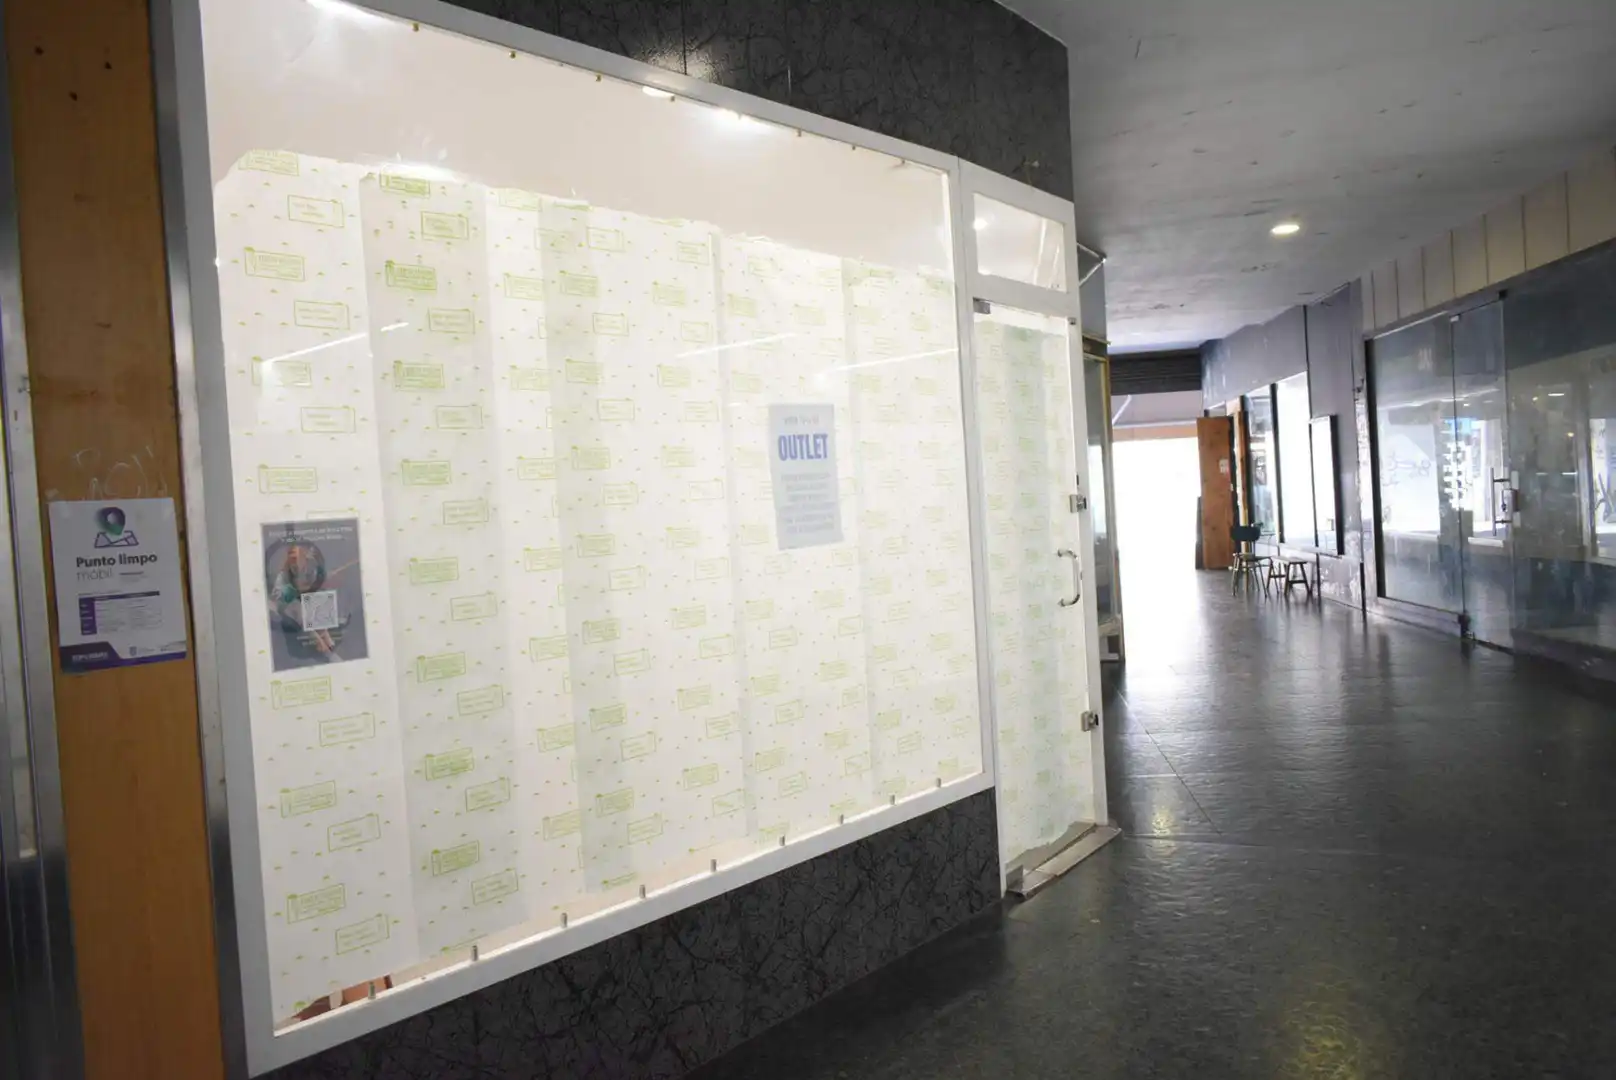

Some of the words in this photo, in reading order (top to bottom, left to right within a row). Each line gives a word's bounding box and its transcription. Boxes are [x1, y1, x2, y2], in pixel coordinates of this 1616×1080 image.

[778, 433, 828, 461] OUTLET
[76, 556, 116, 568] Punto
[119, 552, 158, 566] limpo
